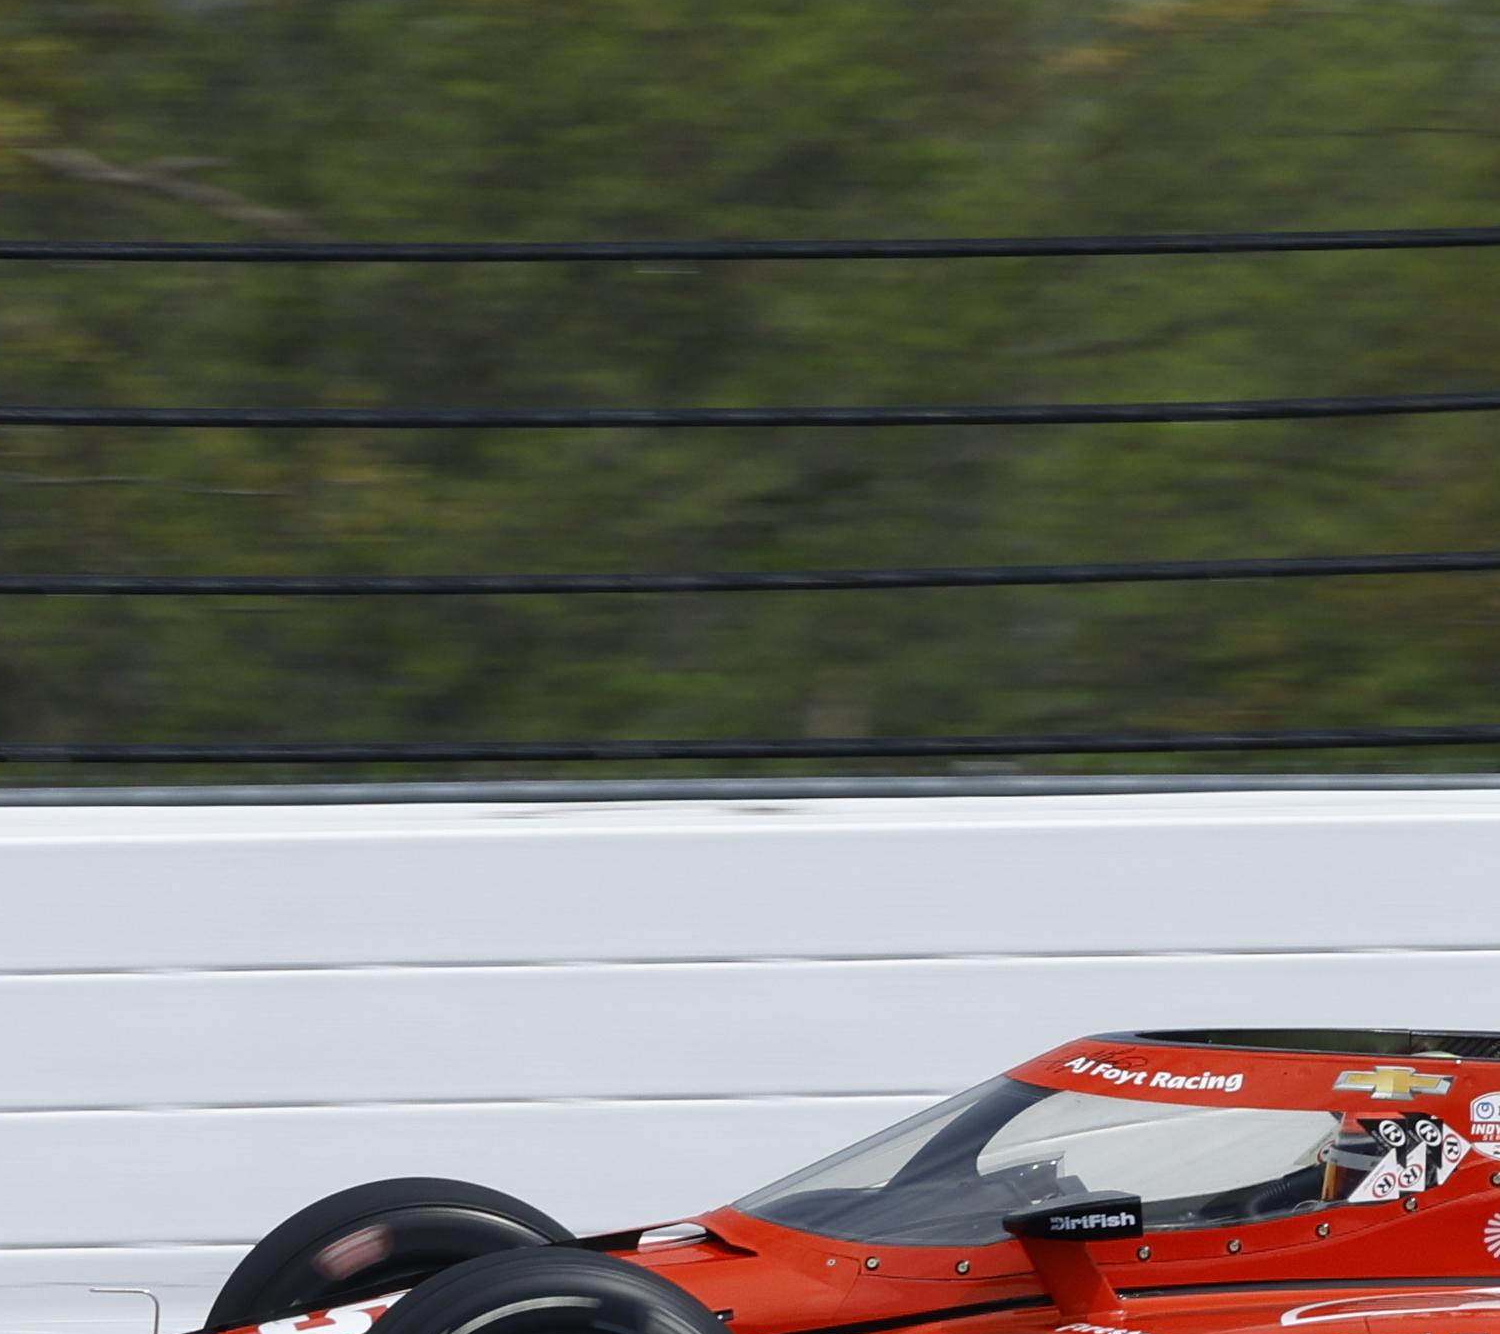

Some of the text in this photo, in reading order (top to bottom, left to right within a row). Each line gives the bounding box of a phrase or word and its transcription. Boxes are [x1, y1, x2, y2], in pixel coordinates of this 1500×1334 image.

[1064, 1056, 1095, 1074] AJ
[1090, 1062, 1148, 1085] Foyt
[1149, 1071, 1244, 1092] Racing
[1050, 1212, 1136, 1231] DirtFish
